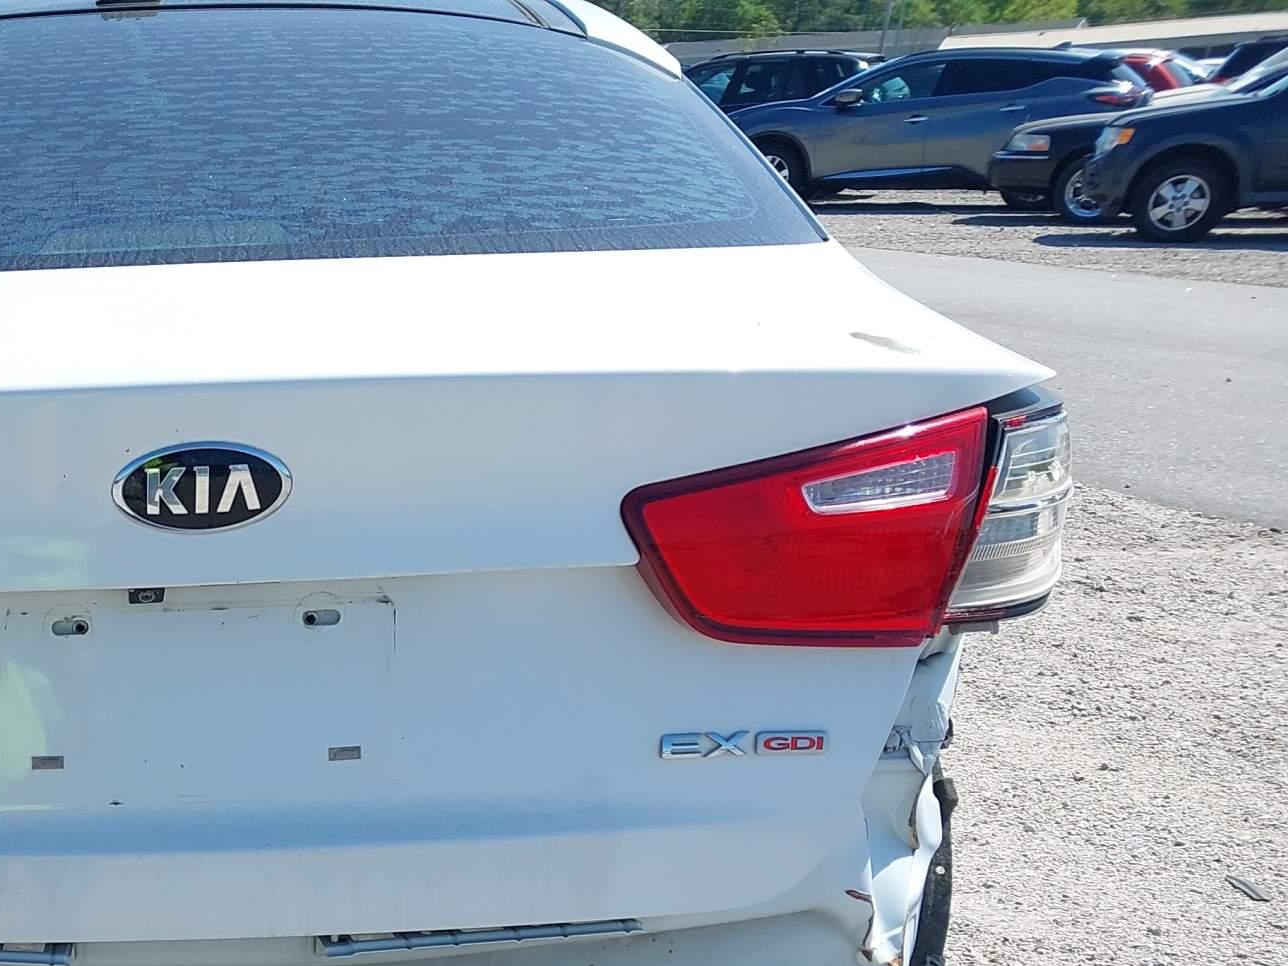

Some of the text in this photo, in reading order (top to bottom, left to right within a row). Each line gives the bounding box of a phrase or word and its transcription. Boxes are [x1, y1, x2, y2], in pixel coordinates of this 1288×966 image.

[144, 464, 261, 515] KIA
[659, 730, 824, 759] EX GDI
